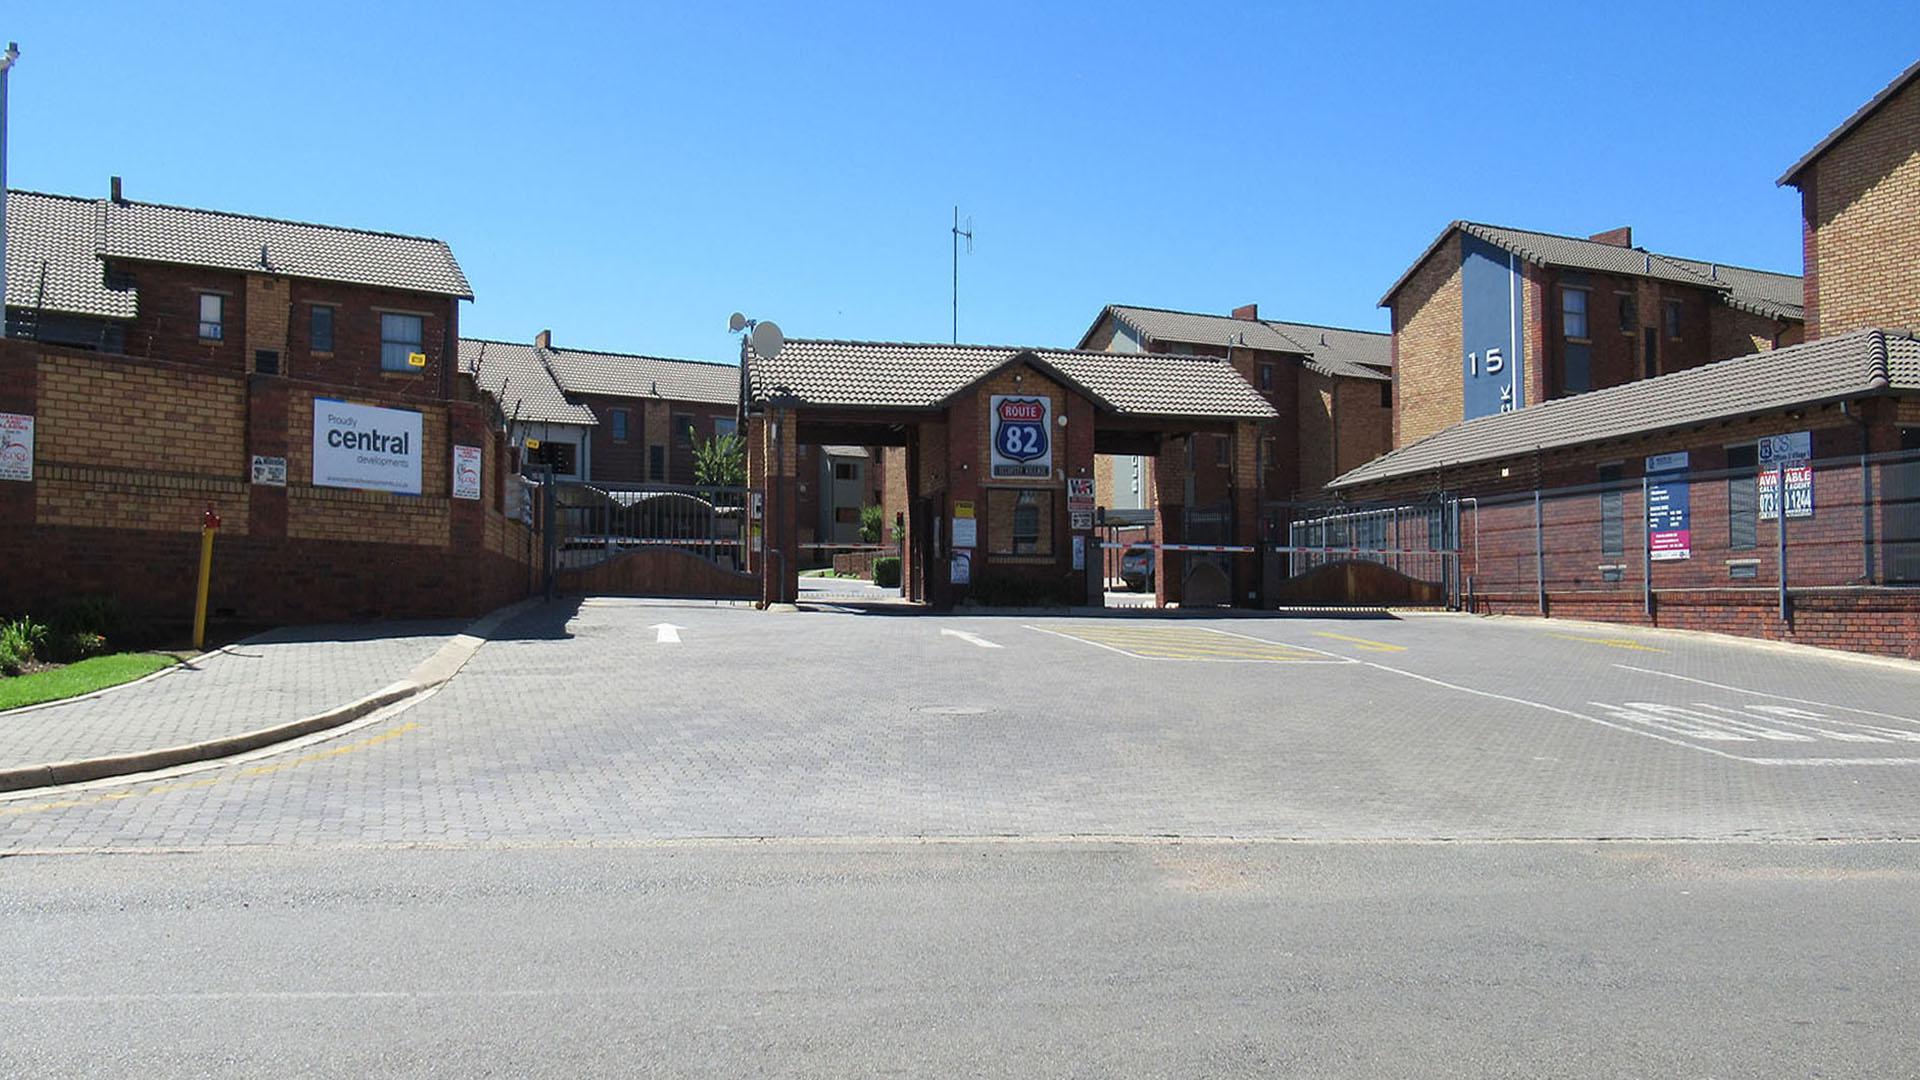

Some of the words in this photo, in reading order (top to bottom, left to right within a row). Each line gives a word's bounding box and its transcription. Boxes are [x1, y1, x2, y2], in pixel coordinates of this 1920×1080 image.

[1468, 348, 1503, 376] 15
[328, 414, 358, 427] Proudly
[1005, 406, 1037, 418] ROUTE
[328, 428, 409, 455] central
[1006, 426, 1038, 453] 82
[1759, 470, 1811, 486] AVAABLE
